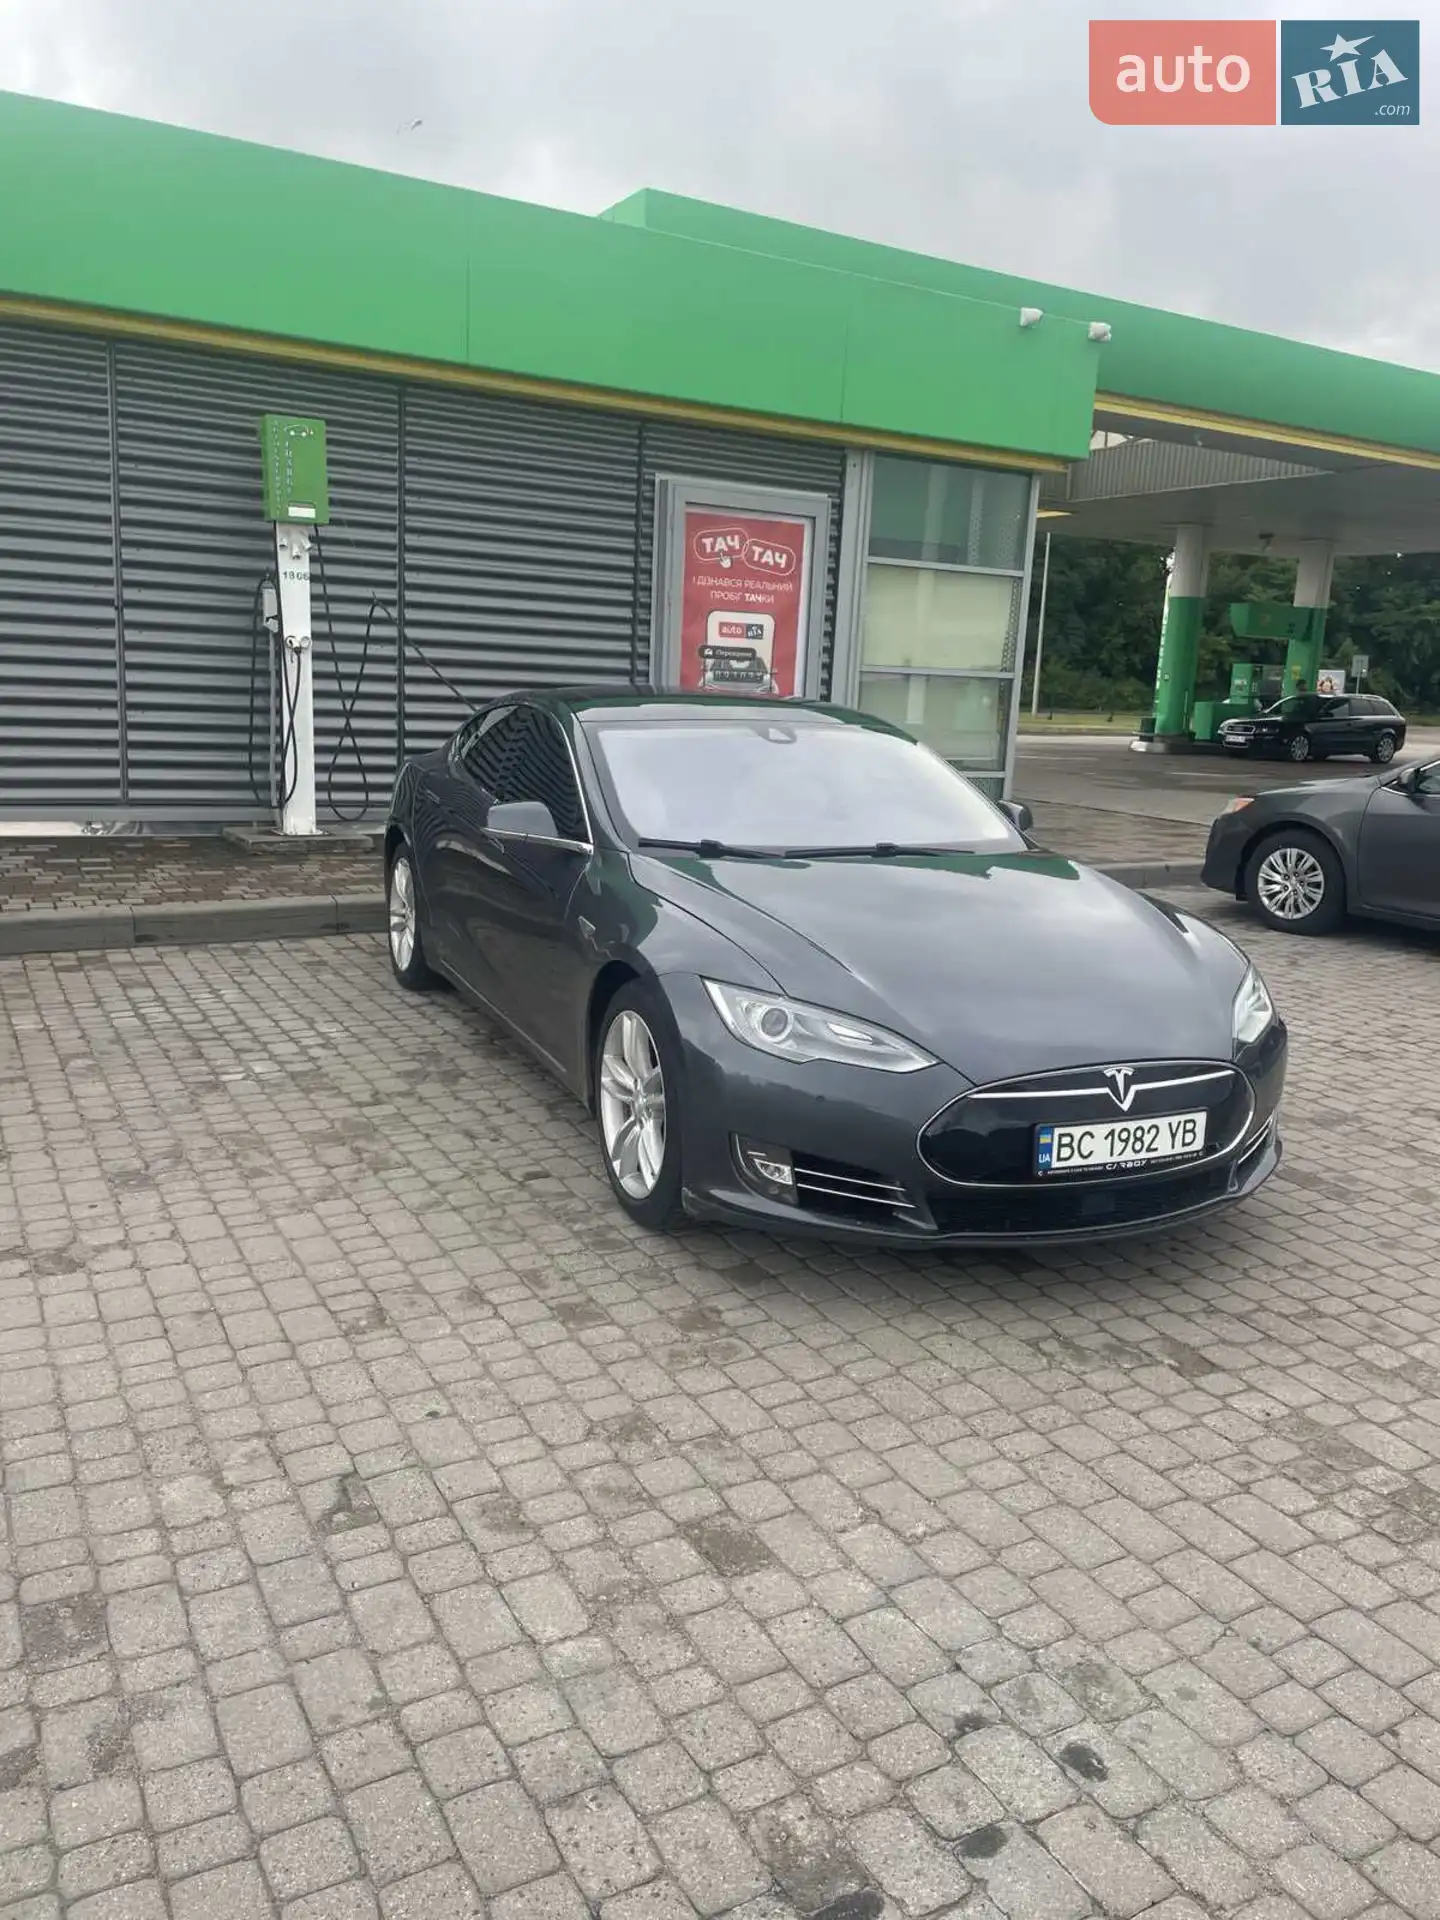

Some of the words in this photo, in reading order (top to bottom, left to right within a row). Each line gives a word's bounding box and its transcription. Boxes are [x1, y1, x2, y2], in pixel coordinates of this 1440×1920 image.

[701, 535, 740, 553] ТАЧ
[751, 546, 787, 568] ТАЧ
[721, 625, 743, 635] auto
[1056, 1131, 1096, 1162] BC
[1103, 1124, 1160, 1157] 1982
[1167, 1118, 1197, 1150] YB
[1038, 1152, 1051, 1164] UA
